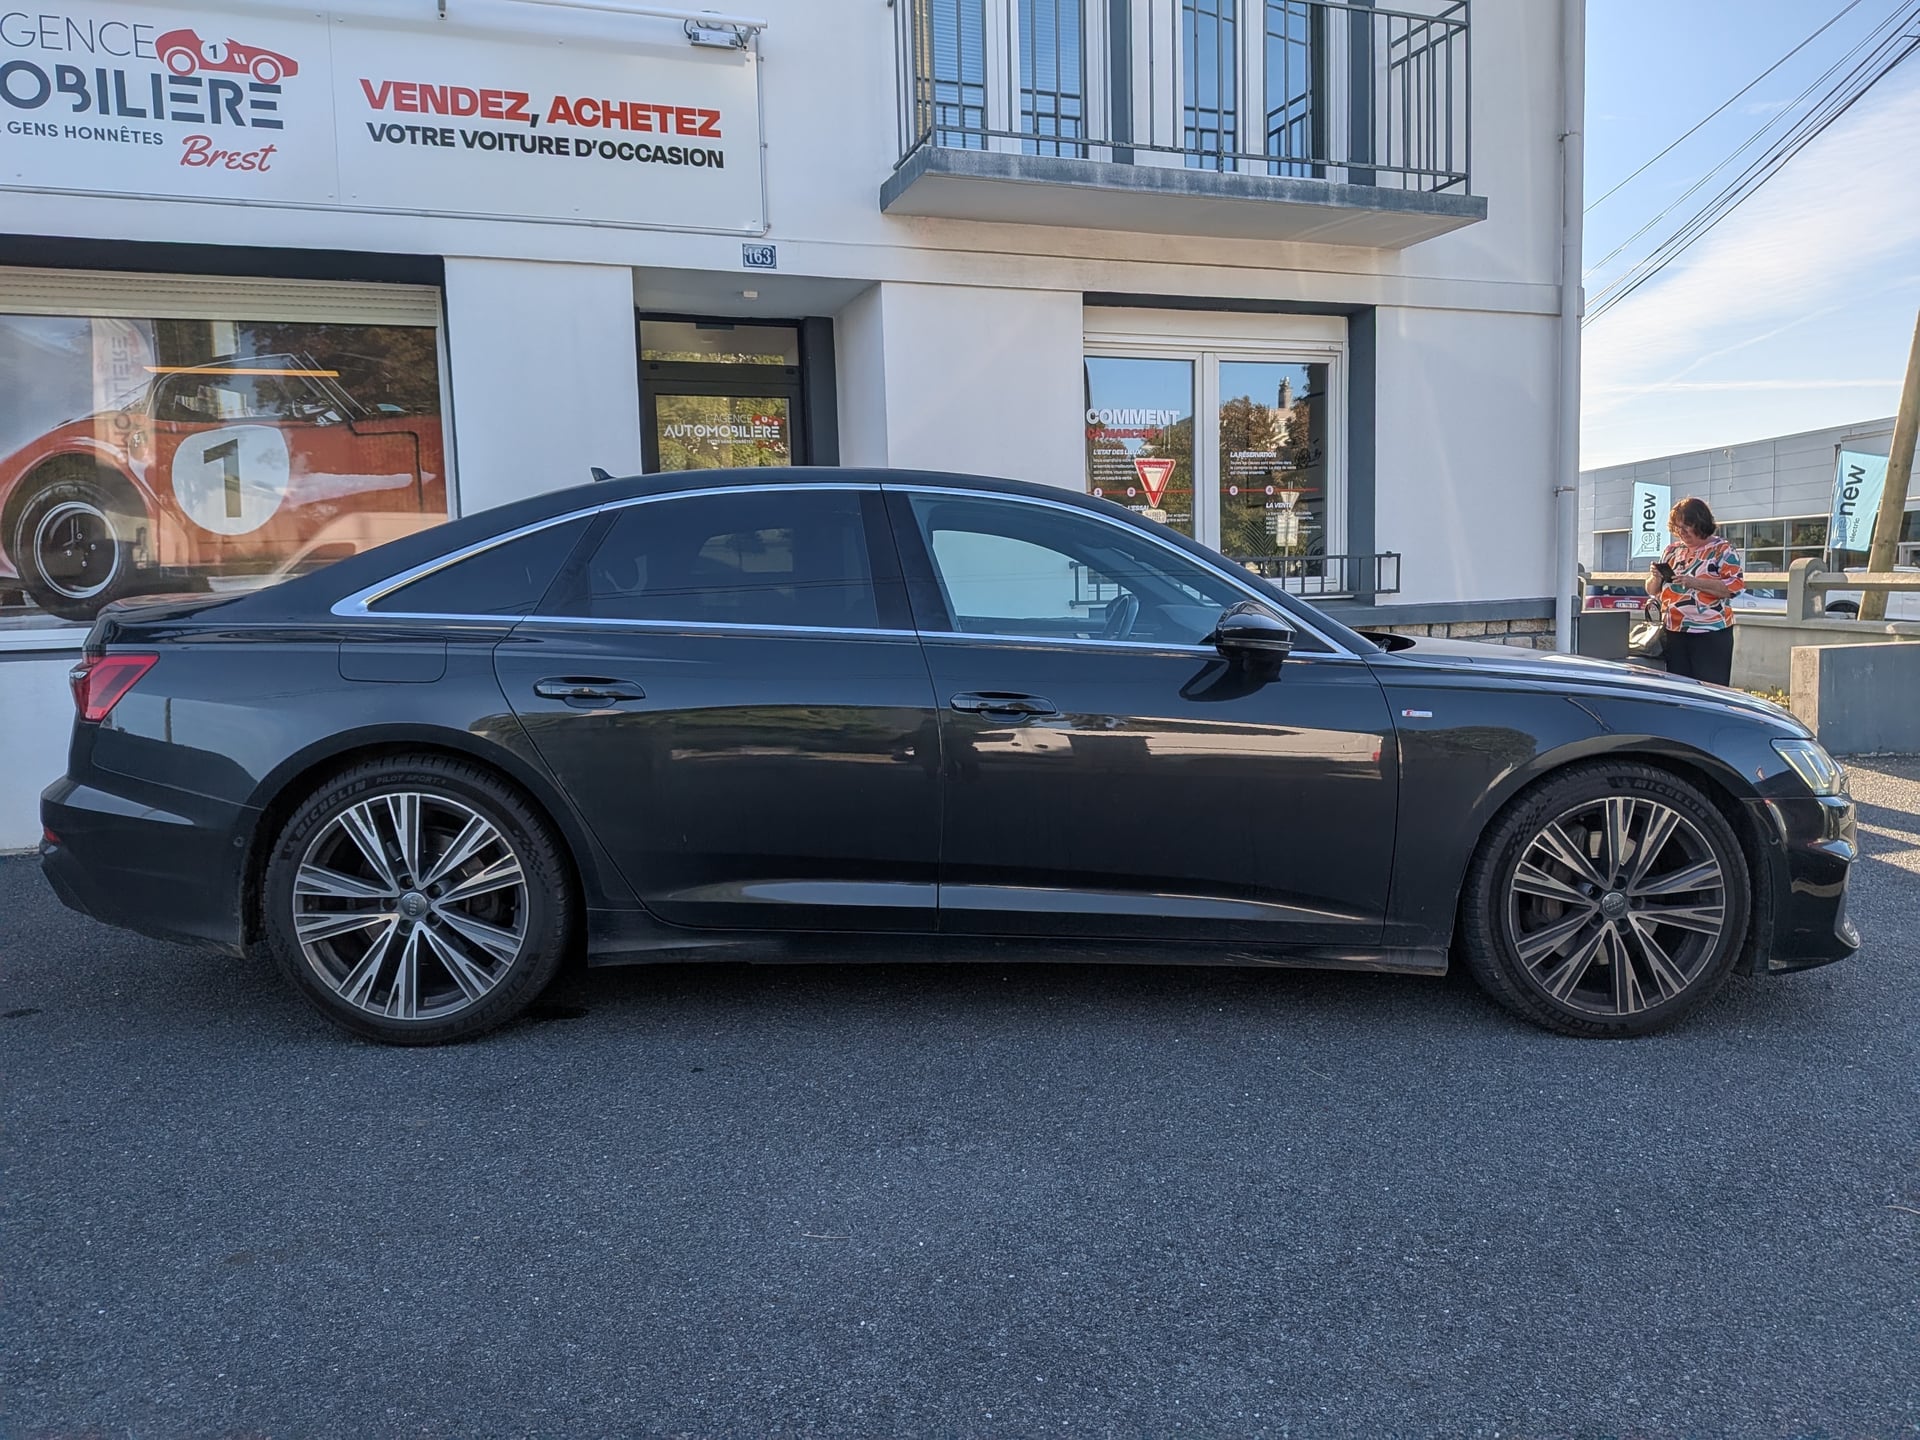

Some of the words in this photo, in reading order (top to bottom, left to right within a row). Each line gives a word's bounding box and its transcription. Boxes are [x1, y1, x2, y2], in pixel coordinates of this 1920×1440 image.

[208, 44, 218, 60] 1
[359, 78, 540, 129] VENDEZ,
[546, 95, 722, 139] ACHETEZ
[7, 120, 59, 138] GENS
[64, 124, 164, 146] HONNÊTES
[366, 122, 455, 149] VOTRE
[459, 129, 570, 157] VOITURE
[574, 139, 725, 169] D'OCCASION
[180, 135, 277, 173] Brest
[748, 247, 772, 264] 163
[1086, 408, 1180, 426] COMMENT
[203, 438, 242, 518] 1
[1641, 492, 1656, 552] renew
[295, 780, 368, 839] MICHELIN
[1633, 780, 1709, 819] MICHELIN
